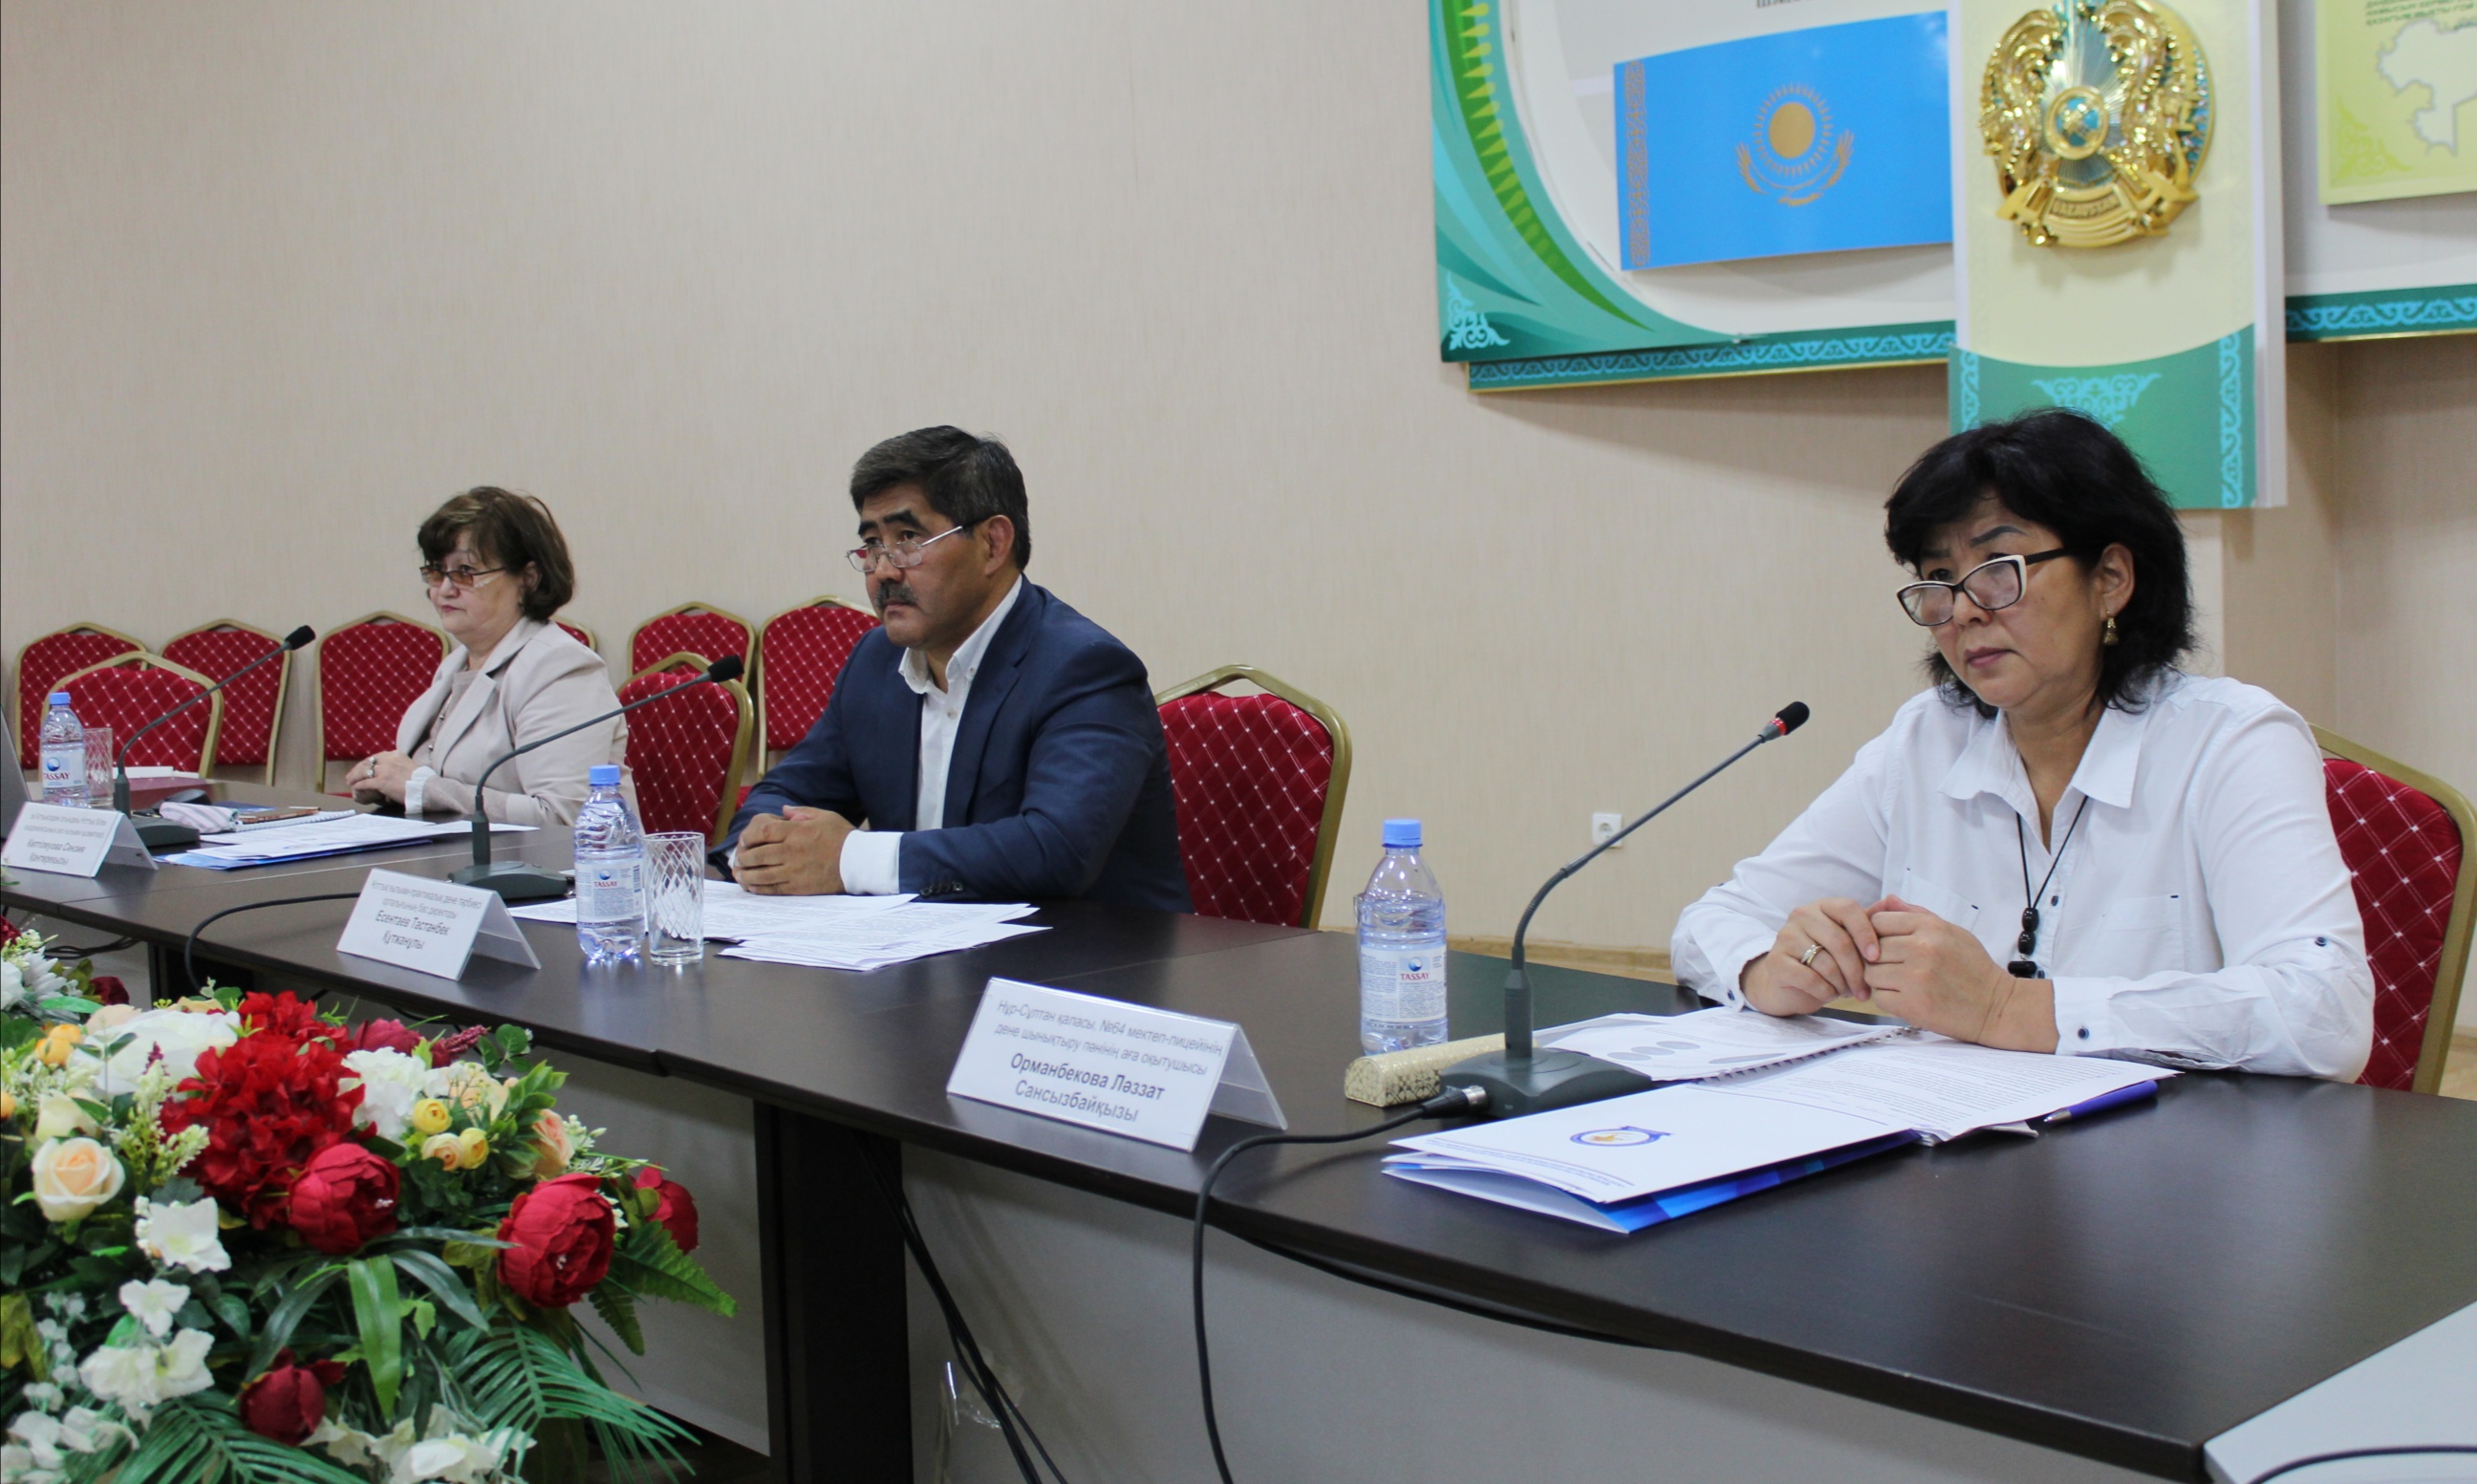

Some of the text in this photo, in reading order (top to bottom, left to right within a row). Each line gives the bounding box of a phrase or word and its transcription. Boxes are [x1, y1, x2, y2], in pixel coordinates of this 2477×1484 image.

[375, 909, 451, 936] Есентаев Тастанбек
[1400, 972, 1430, 980] TASSAY
[994, 1022, 1021, 1038] дене
[1021, 1029, 1082, 1051] шынықтыру
[1120, 1047, 1140, 1063] аға
[1140, 1052, 1208, 1077] оқытушысы
[997, 1000, 1056, 1022] Нұр-Сұлтан
[1099, 1019, 1127, 1035] №64
[1127, 1027, 1223, 1058] мектеп-лицейінің
[1010, 1052, 1166, 1101] Орманбекова Ләззат
[1015, 1079, 1140, 1123] Сансызбайқызы
